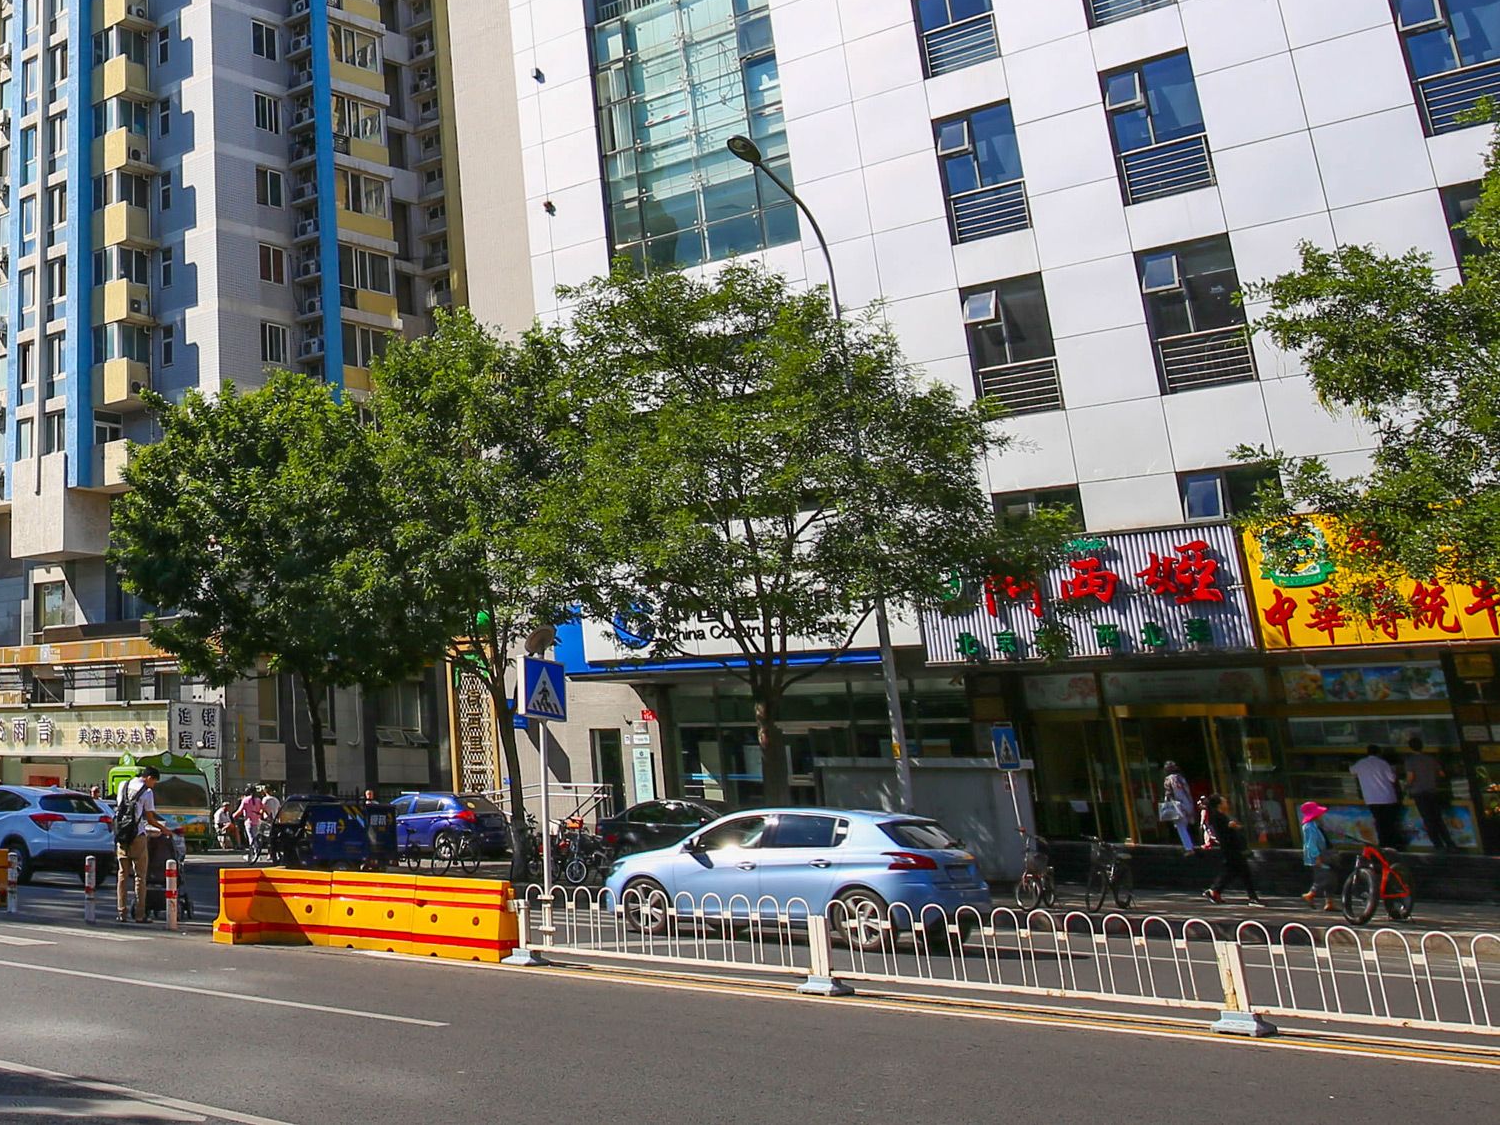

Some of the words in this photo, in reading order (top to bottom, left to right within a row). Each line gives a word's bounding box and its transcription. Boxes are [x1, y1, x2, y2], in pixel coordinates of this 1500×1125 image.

[178, 708, 216, 727] 连锁
[78, 725, 157, 745] 美容美发连锁
